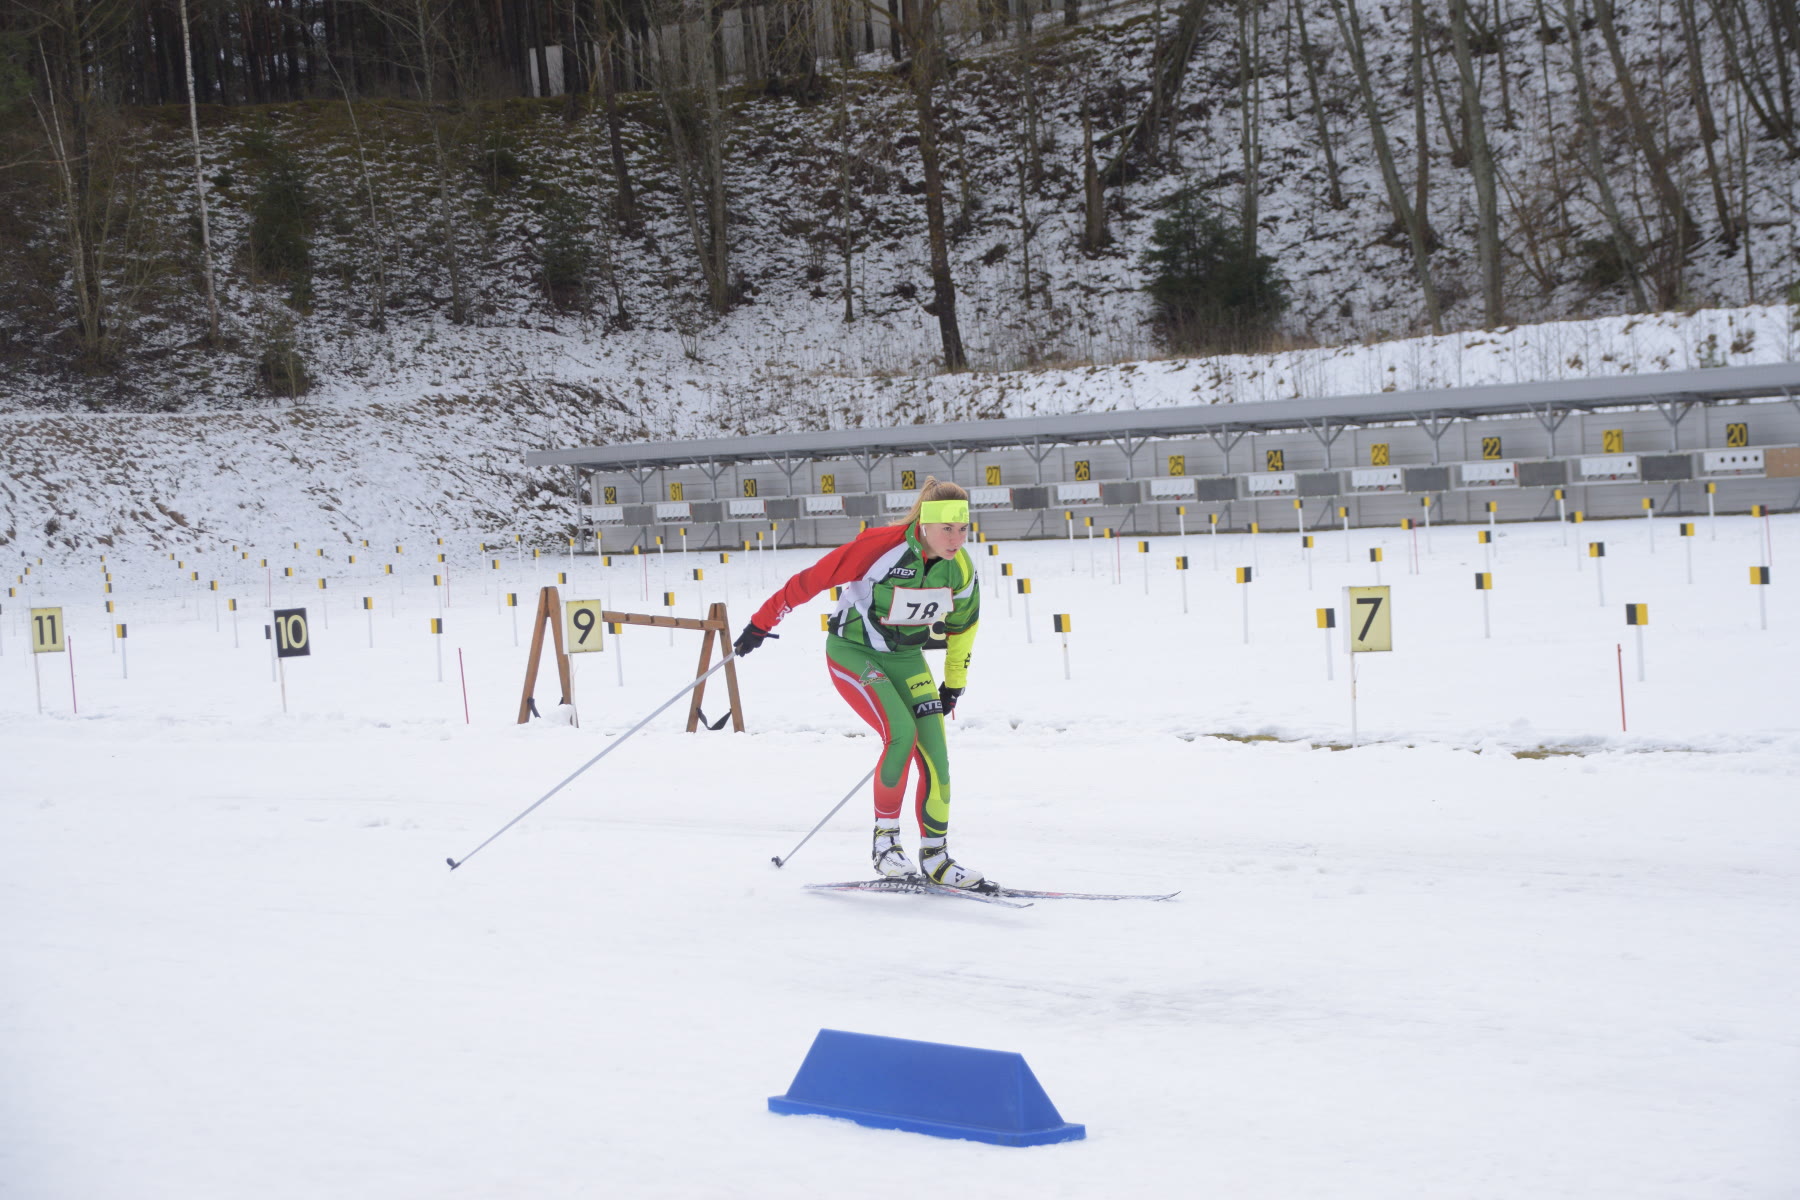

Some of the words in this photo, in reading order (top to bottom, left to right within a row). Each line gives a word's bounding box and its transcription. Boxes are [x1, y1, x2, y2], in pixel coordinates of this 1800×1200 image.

[1605, 431, 1621, 452] 21
[1727, 423, 1747, 447] 20
[1373, 445, 1387, 465] 23
[1483, 438, 1500, 459] 22
[1170, 456, 1183, 476] 25
[1267, 450, 1283, 471] 24
[902, 471, 916, 490] 28
[987, 466, 1000, 486] 27
[1075, 461, 1089, 481] 26
[671, 483, 682, 501] 31
[744, 479, 756, 497] 30
[821, 475, 834, 494] 29
[604, 487, 616, 504] 32
[889, 567, 916, 576] ATEX
[906, 602, 939, 620] 78
[1356, 597, 1383, 642] 7
[34, 615, 57, 645] 11
[276, 614, 307, 649] 10
[573, 608, 595, 645] 9
[859, 882, 926, 892] MADSHUS
